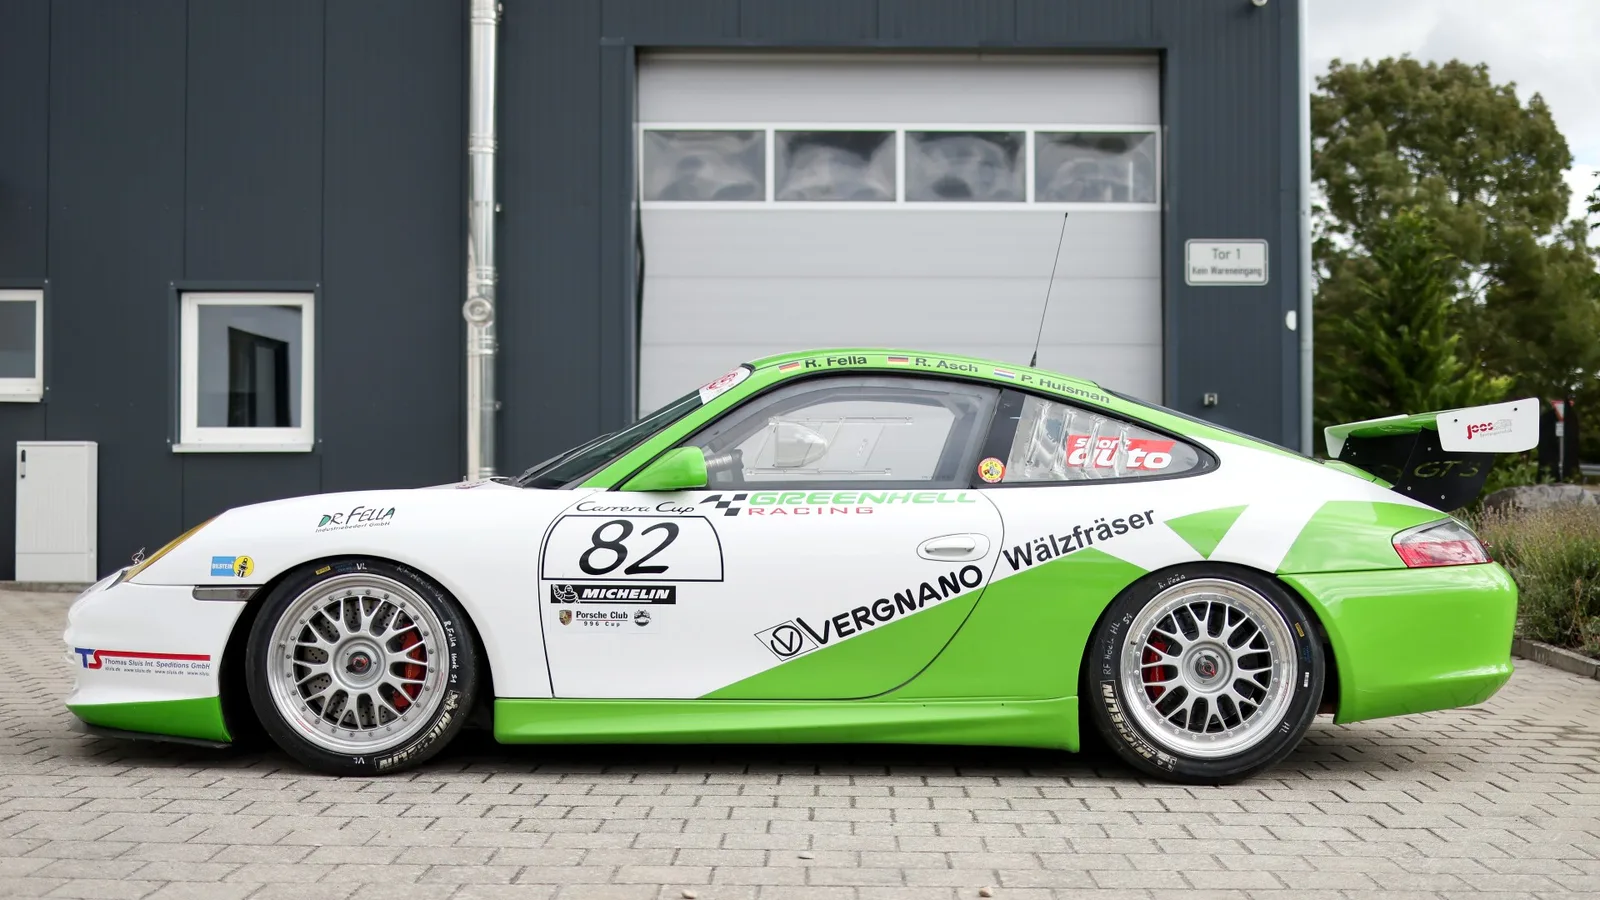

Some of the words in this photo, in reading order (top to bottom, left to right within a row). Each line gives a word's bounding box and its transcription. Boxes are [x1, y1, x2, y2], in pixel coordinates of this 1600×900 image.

[1211, 248, 1231, 260] Tor
[1236, 248, 1241, 260] 1
[1192, 266, 1209, 275] Kein
[1210, 266, 1263, 278] Wareneingang
[804, 359, 822, 369] R.
[827, 355, 868, 367] Fella
[915, 357, 931, 368] R.
[938, 360, 979, 373] Asch
[1021, 374, 1034, 384] P.
[1039, 376, 1111, 404] Huisman
[1068, 447, 1173, 469] auto
[749, 491, 976, 506] GREENHELL
[576, 500, 651, 513] Carrera
[655, 501, 695, 515] Cup
[748, 507, 874, 516] RACING
[317, 511, 343, 528] DR.
[345, 505, 396, 526] FELLA
[578, 519, 680, 576] 82
[795, 564, 983, 645] VERGNANO
[1002, 508, 1155, 572] Wälzfräser
[582, 588, 671, 600] MICHELIN
[575, 610, 608, 619] Porsche
[609, 610, 629, 619] Club
[75, 647, 102, 670] TS
[104, 657, 127, 666] Thomas
[128, 659, 144, 667] Sluis
[156, 660, 189, 670] Speditions
[190, 662, 211, 670] GmbH
[1100, 683, 1153, 760] MICHELIN
[379, 712, 453, 770] MICELIN
